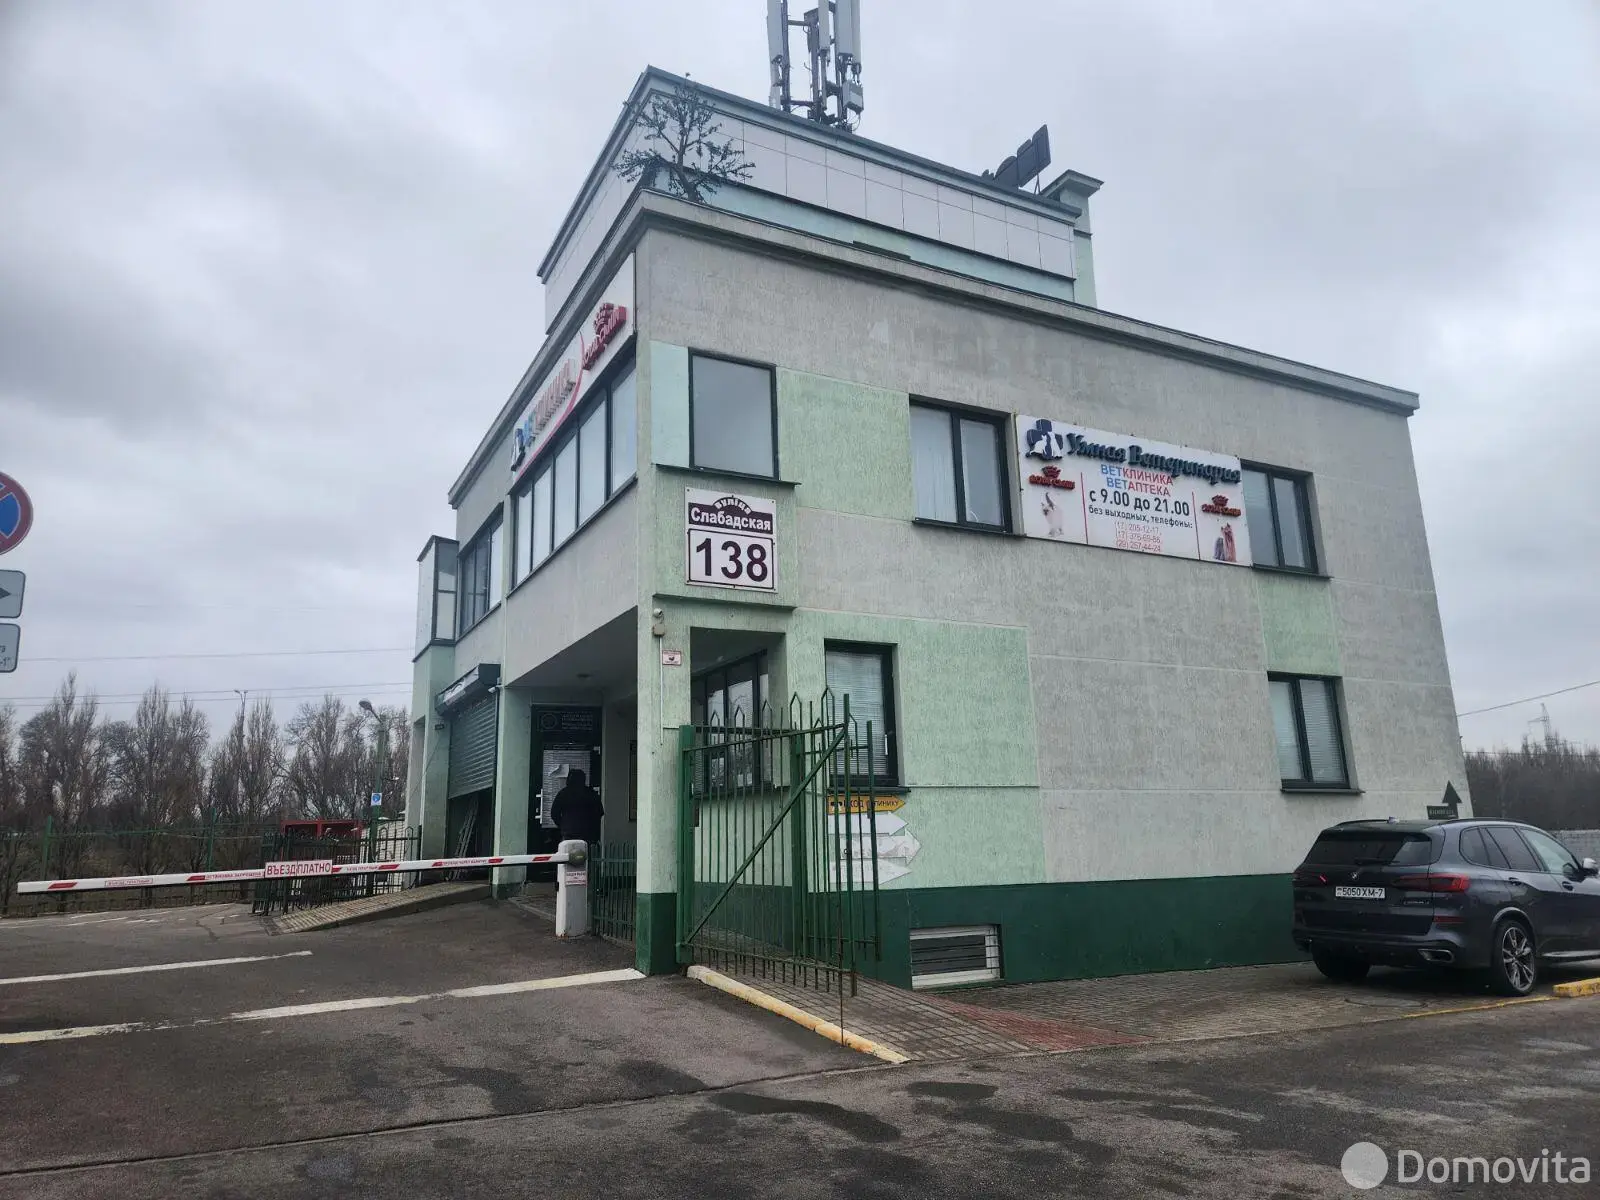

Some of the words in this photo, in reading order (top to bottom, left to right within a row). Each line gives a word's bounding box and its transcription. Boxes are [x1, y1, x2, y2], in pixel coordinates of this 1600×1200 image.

[1066, 432, 1127, 463] Умная
[1128, 444, 1241, 486] Ветеринария
[1101, 464, 1174, 486] ВЕТКЛИНИКА
[1106, 477, 1171, 497] ВЕТАПТЕКА
[714, 498, 752, 515] вуліца
[1089, 490, 1097, 502] с
[1100, 488, 1130, 507] 9.00
[1133, 497, 1150, 511] до
[1154, 497, 1190, 516] 21.00
[690, 507, 771, 531] Слабадская
[1088, 505, 1103, 515] без
[1105, 509, 1150, 523] выходных,
[1150, 515, 1193, 529] телефоны:
[696, 537, 768, 582] 138
[266, 864, 297, 876] ВЪЕЗД
[297, 862, 331, 875] ПЛАТНО
[1342, 887, 1360, 898] 5050
